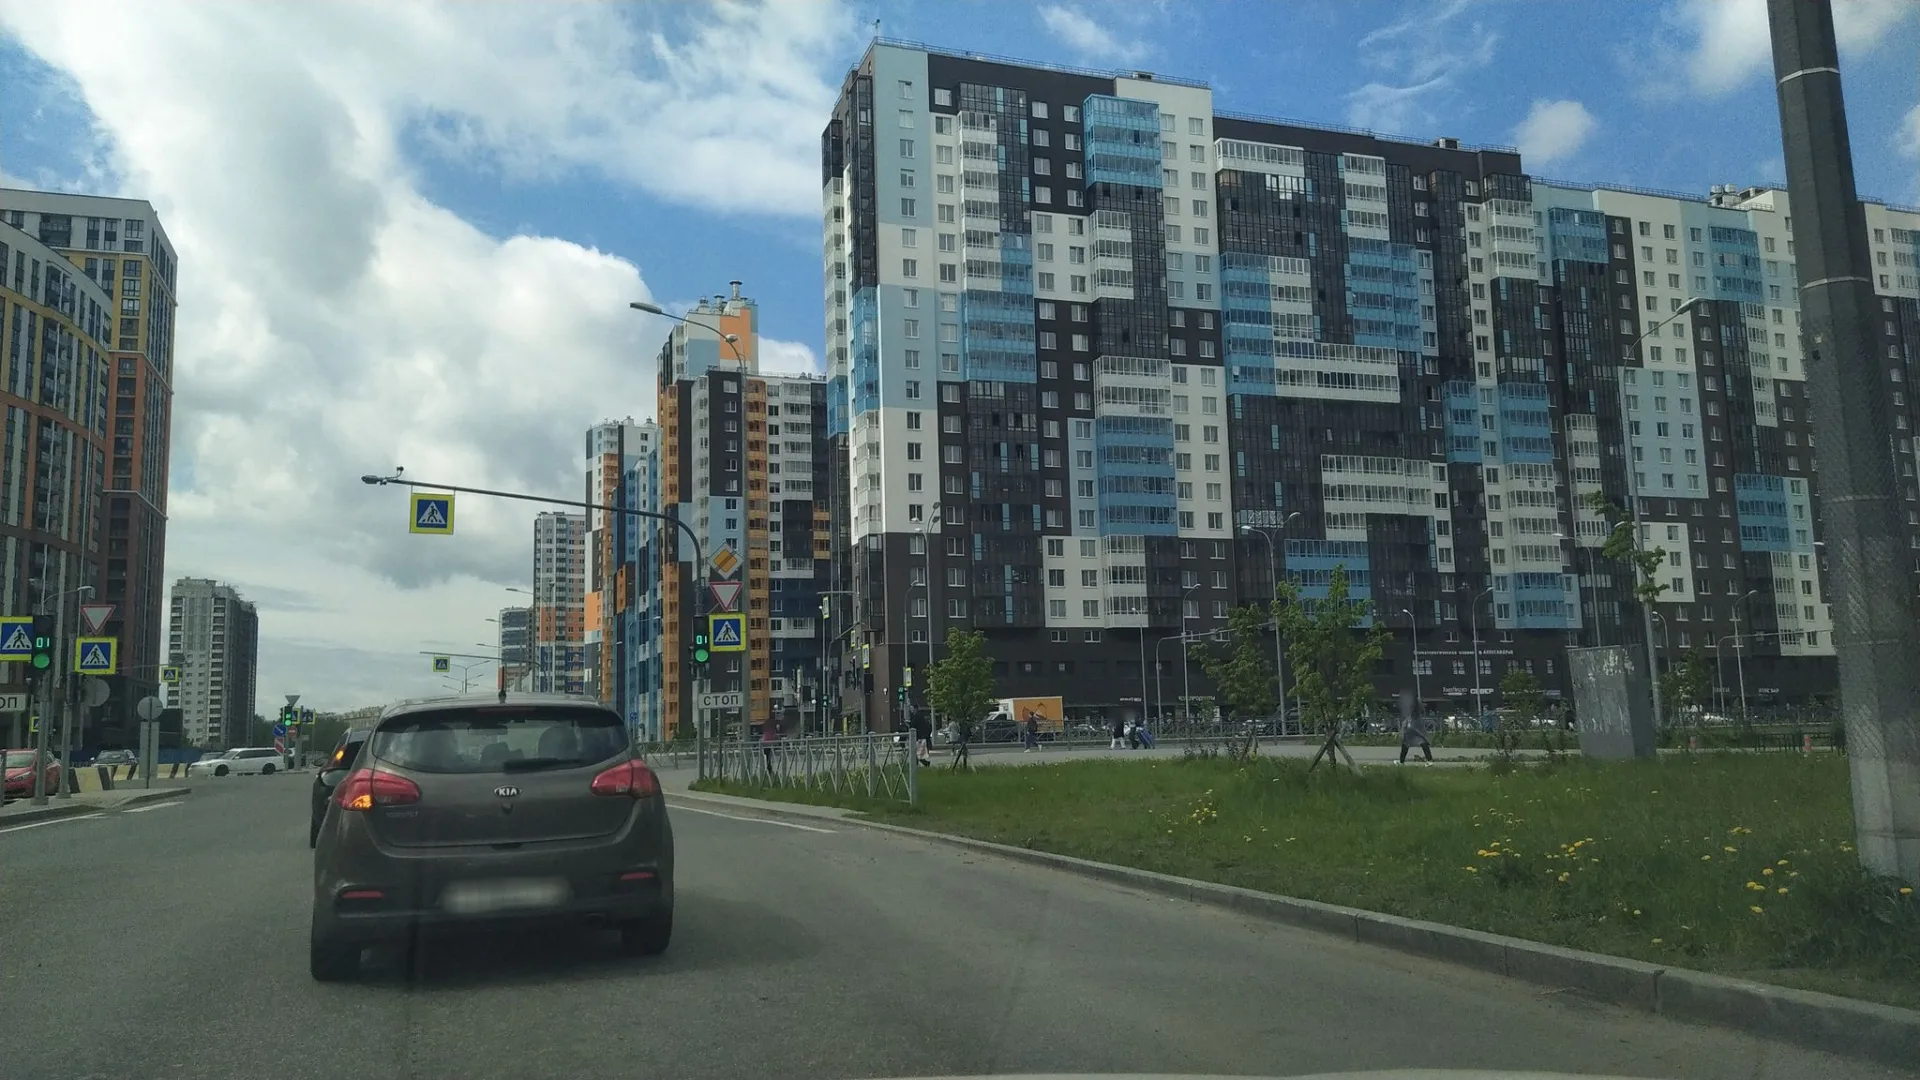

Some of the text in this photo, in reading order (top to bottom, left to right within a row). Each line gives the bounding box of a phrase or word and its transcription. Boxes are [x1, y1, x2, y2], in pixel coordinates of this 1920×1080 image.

[36, 636, 50, 648] 01
[696, 635, 708, 645] 01
[703, 695, 739, 706] СТОП
[498, 787, 517, 796] KIA
